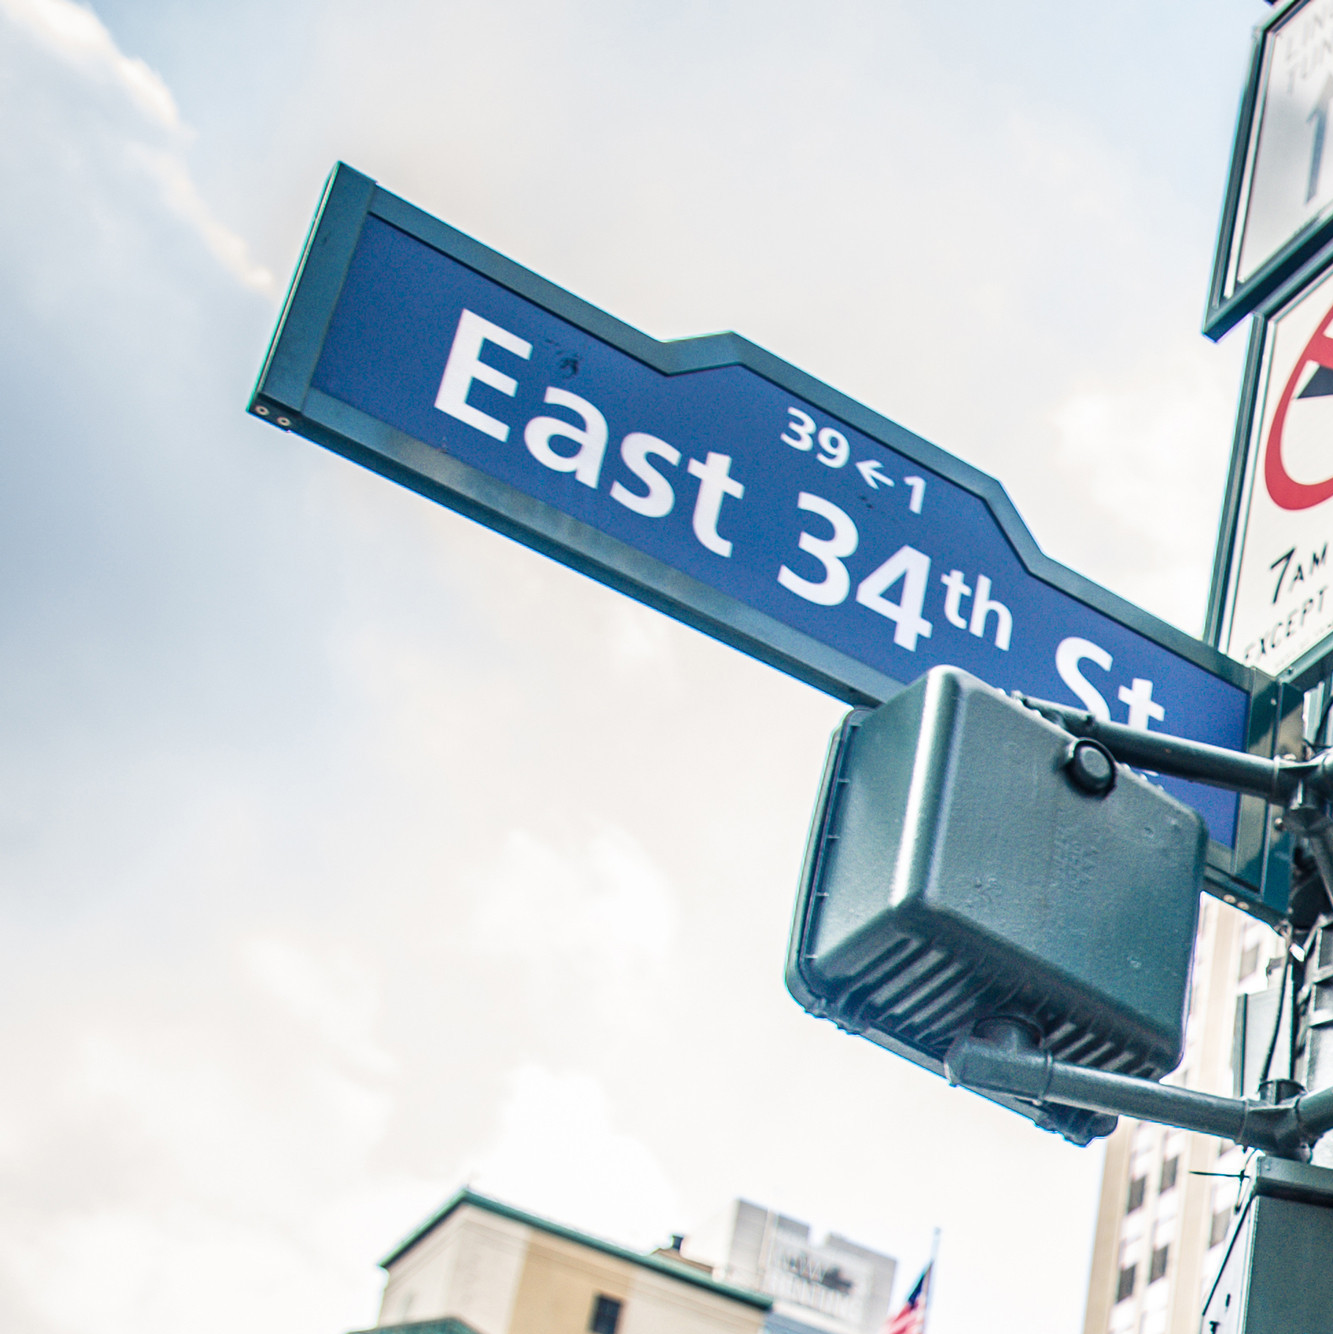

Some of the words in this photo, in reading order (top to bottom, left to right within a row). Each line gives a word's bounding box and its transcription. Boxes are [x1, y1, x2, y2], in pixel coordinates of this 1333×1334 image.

[781, 407, 849, 468] 39
[904, 476, 925, 513] 1
[434, 309, 743, 557] East
[777, 492, 1012, 651] 34th
[1055, 635, 1166, 732] St
[1244, 584, 1328, 662] EXCEPT
